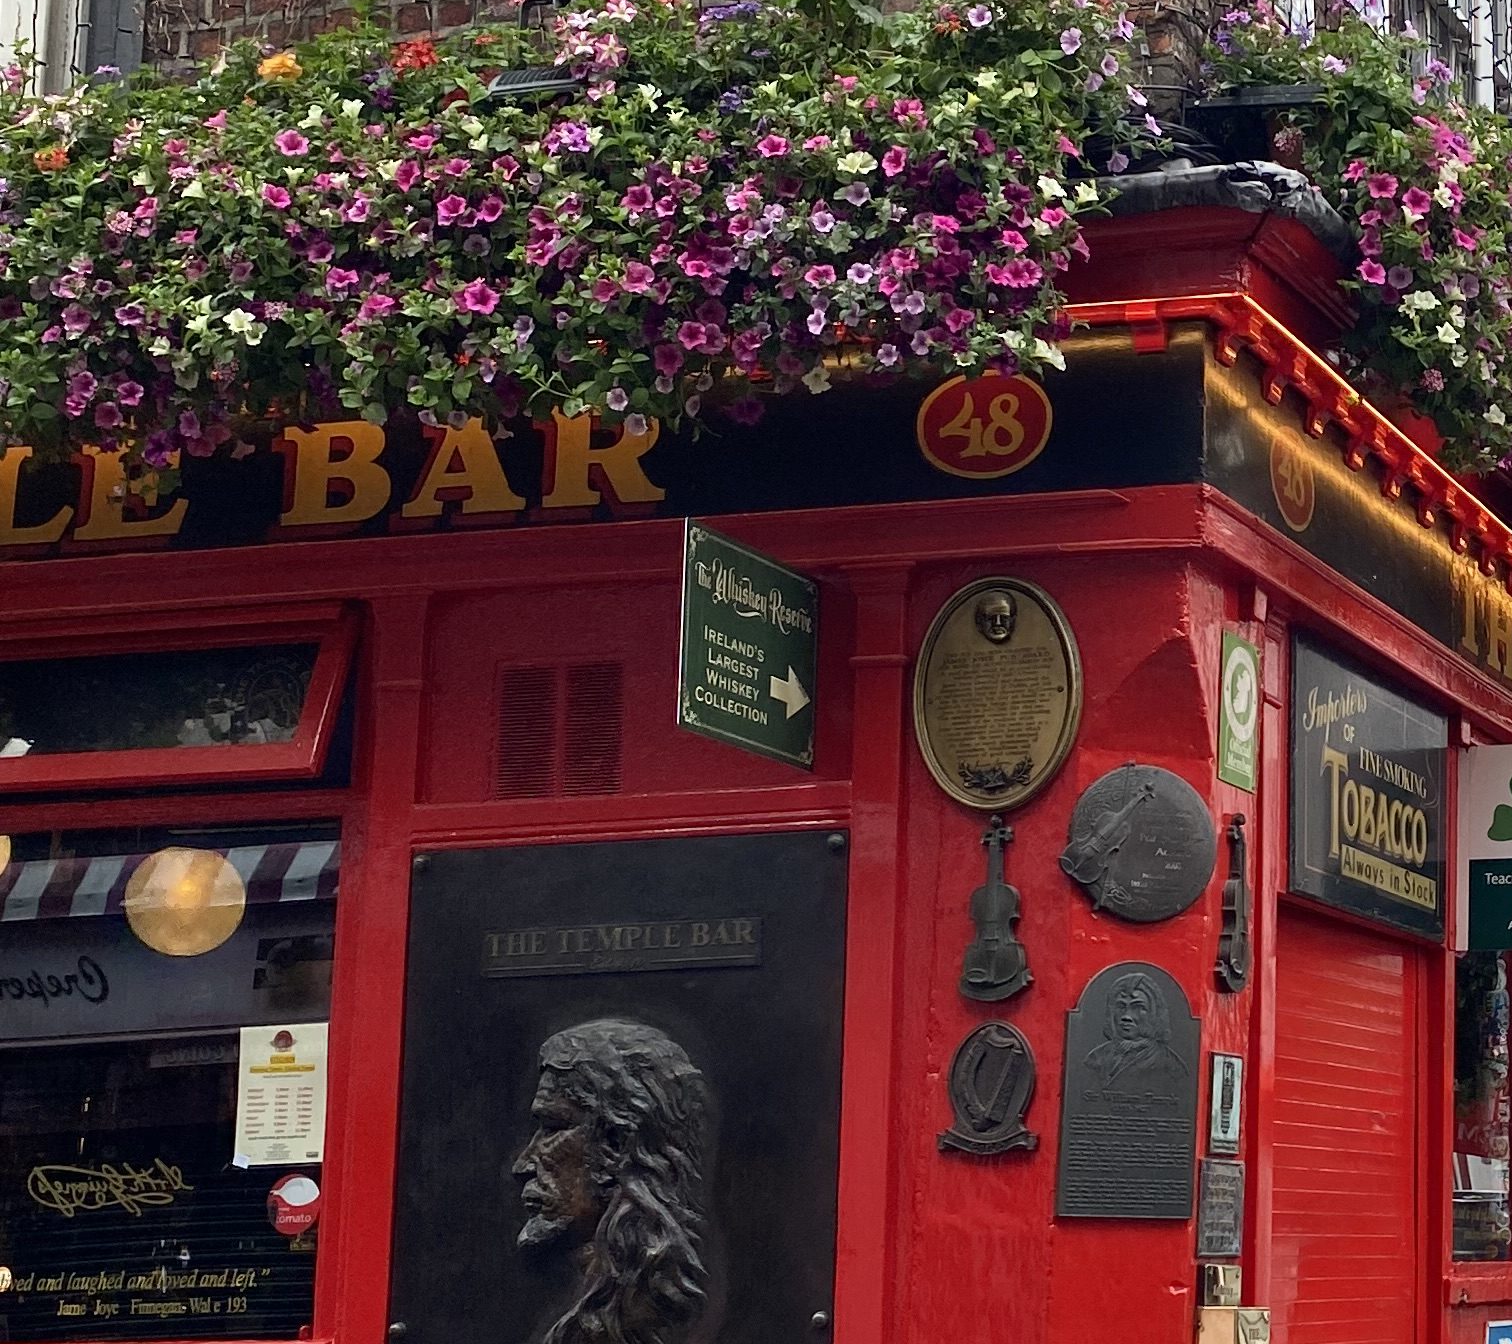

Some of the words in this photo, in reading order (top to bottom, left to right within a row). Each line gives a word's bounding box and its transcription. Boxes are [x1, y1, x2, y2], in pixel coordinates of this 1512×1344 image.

[938, 391, 1027, 460] 48
[281, 404, 667, 527] BAR
[694, 560, 712, 590] The
[712, 558, 769, 618] Whiskey
[767, 587, 813, 635] Reserve
[704, 624, 766, 663] IRELAND'S
[708, 647, 760, 682] LARGEST
[695, 685, 769, 726] COLLECTION
[706, 668, 760, 703] WHISKEY
[1303, 685, 1368, 744] Importers
[1343, 722, 1356, 744] OF
[1359, 746, 1383, 779] FINE
[1383, 758, 1427, 799] SMOKING
[1320, 743, 1428, 869] TOBACCO
[1343, 851, 1385, 884] Always
[1389, 872, 1399, 892] in
[1403, 870, 1435, 905] Stock
[484, 929, 550, 958] THE
[557, 922, 681, 956] TEMPLE
[691, 918, 757, 946] BAR
[36, 1272, 63, 1292] and
[66, 1269, 124, 1295] laughed
[127, 1270, 154, 1291] and
[199, 1267, 229, 1288] and
